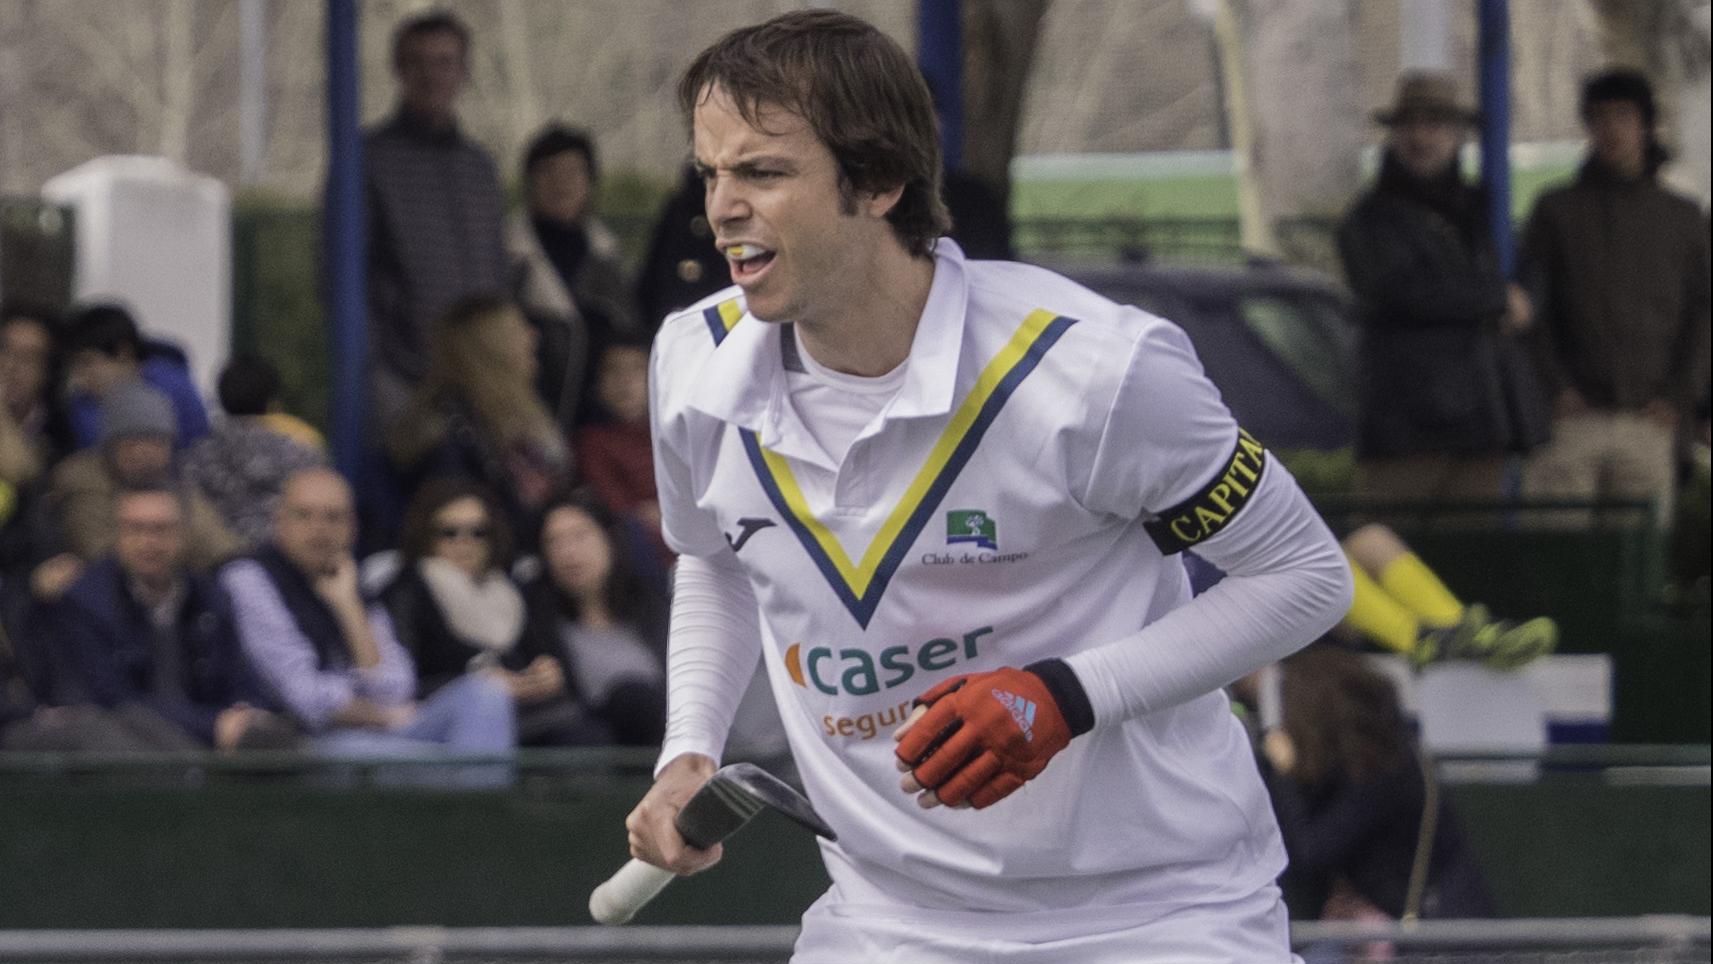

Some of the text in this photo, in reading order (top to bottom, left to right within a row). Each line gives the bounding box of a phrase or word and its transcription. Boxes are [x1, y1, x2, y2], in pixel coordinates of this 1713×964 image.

[921, 551, 1030, 566] Club de Campo
[806, 625, 994, 697] caser
[823, 700, 909, 741] segur
